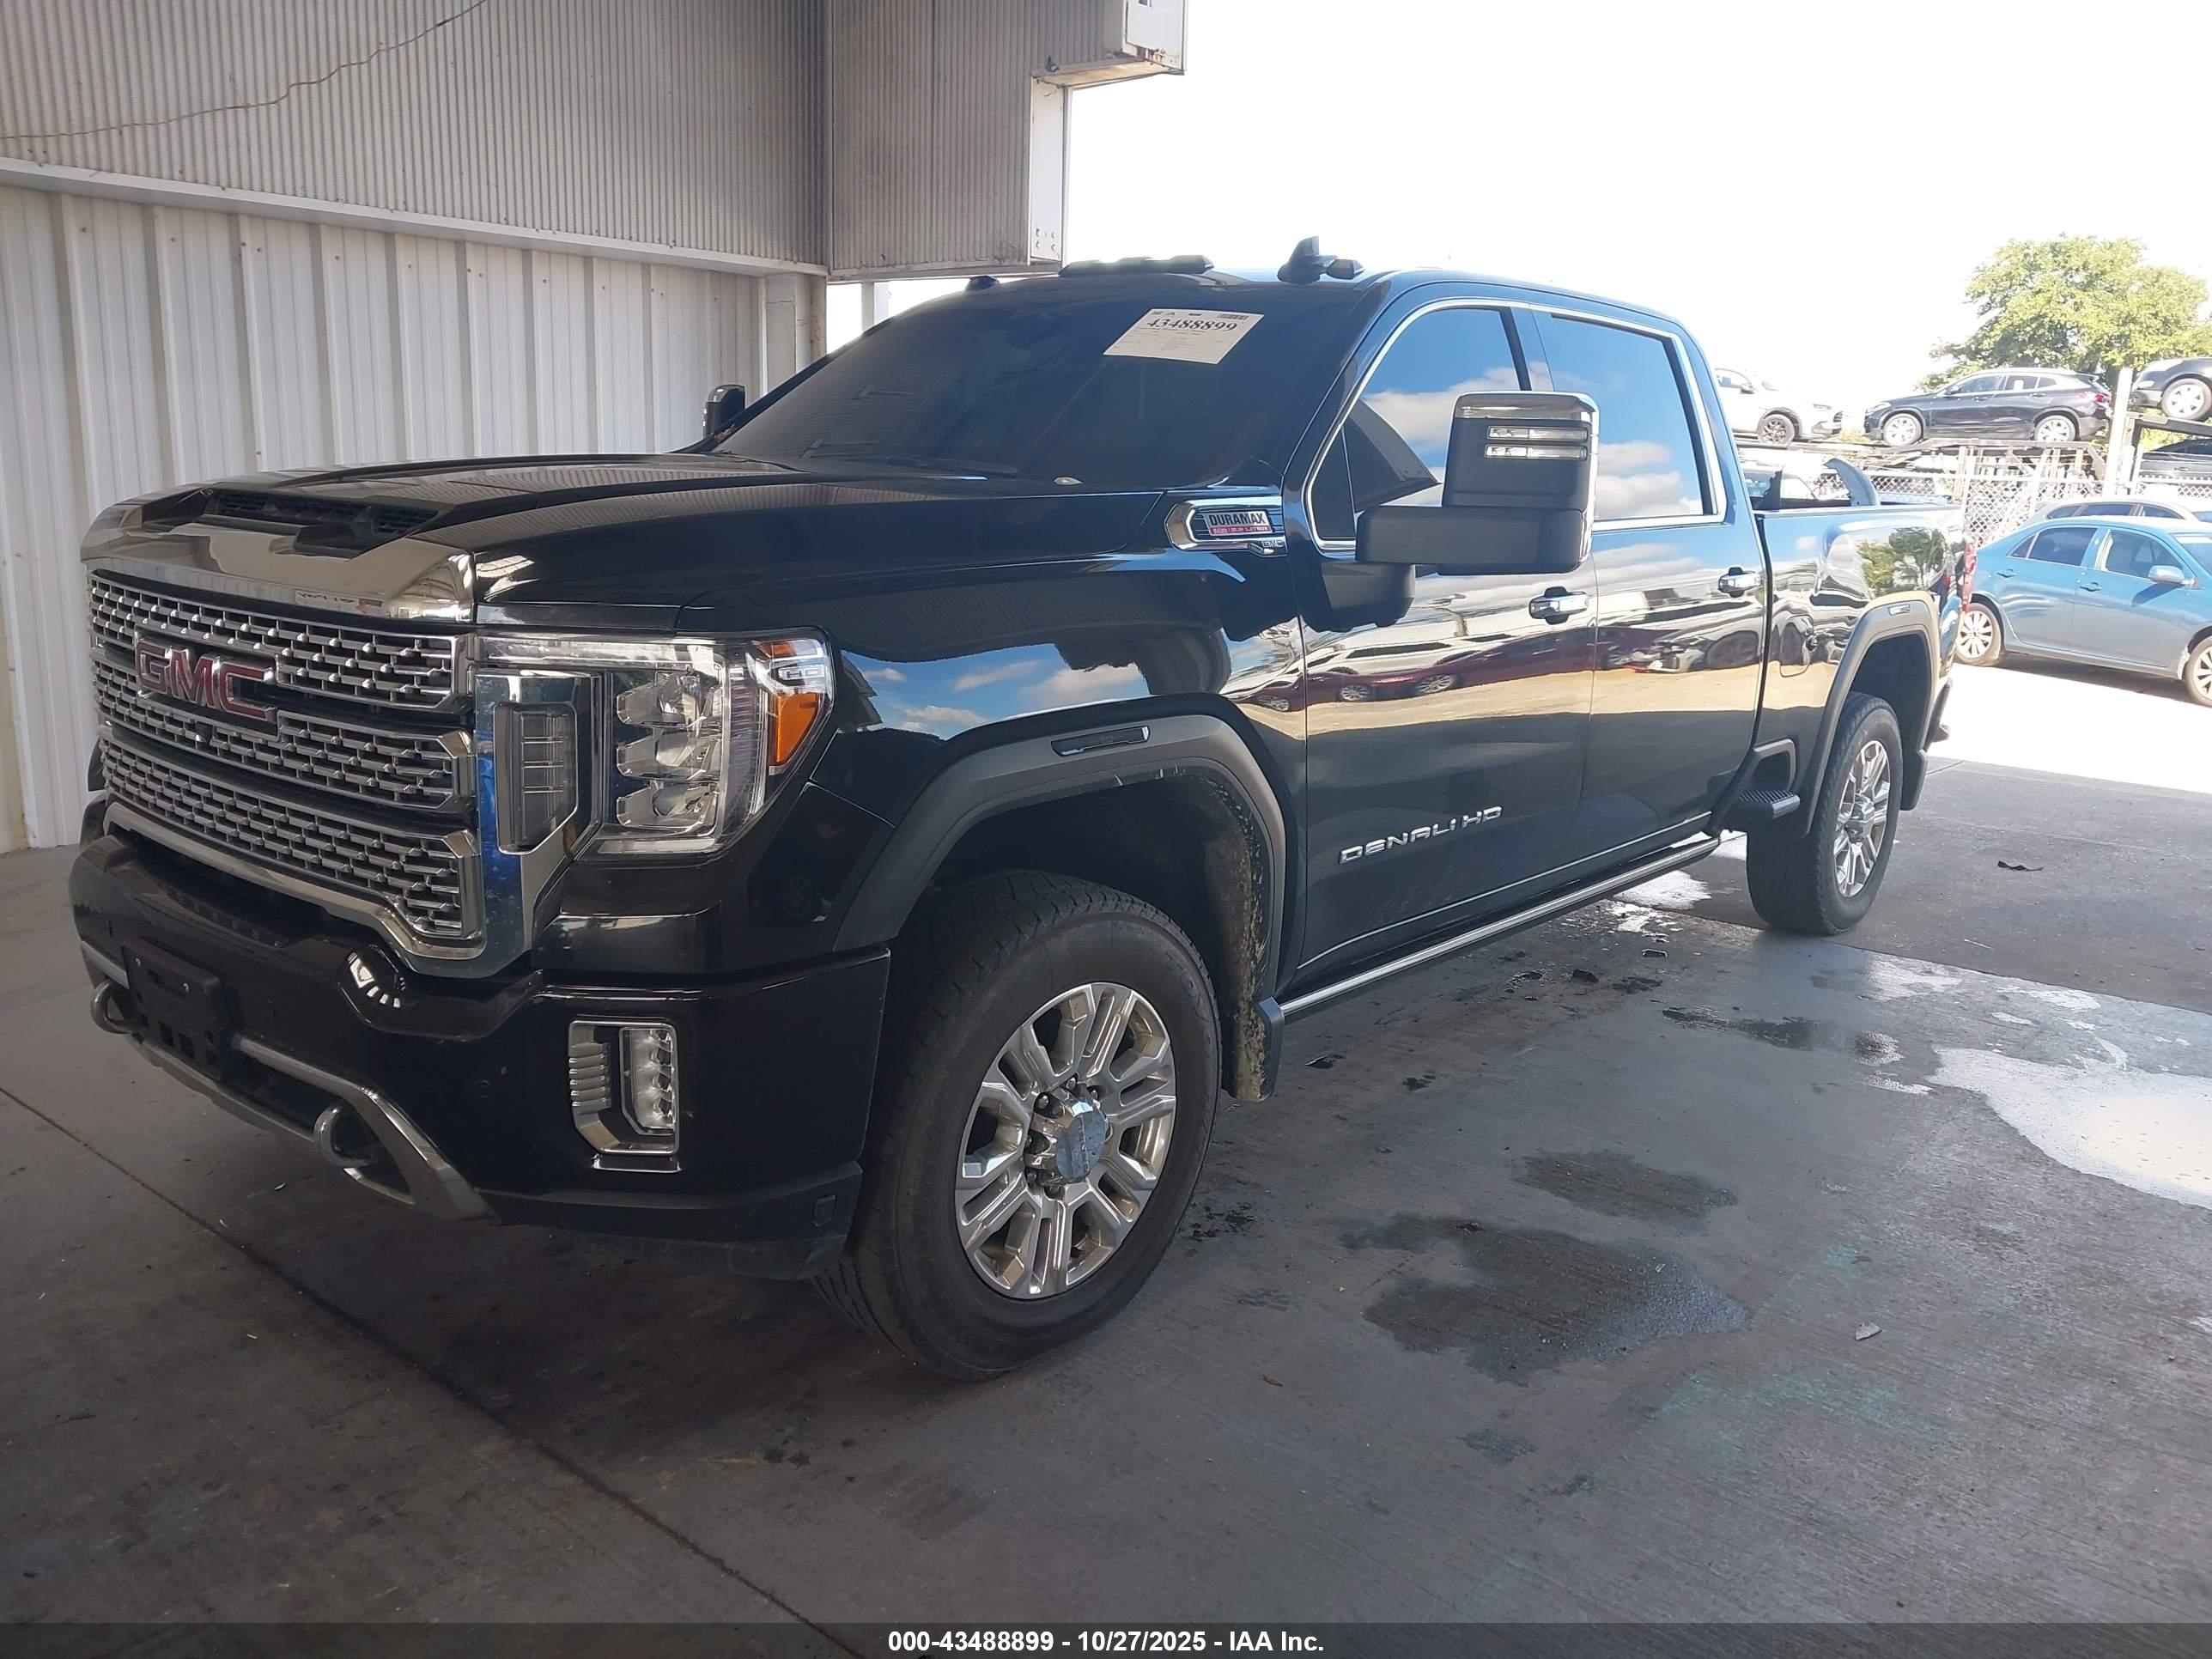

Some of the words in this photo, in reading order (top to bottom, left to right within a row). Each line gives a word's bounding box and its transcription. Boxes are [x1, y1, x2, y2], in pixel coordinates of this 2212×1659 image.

[1146, 317, 1237, 331] 43488899
[1208, 511, 1267, 526] DURAMAX
[135, 639, 274, 722] GMC
[1340, 818, 1456, 864] DENALI
[1462, 805, 1503, 828] HD
